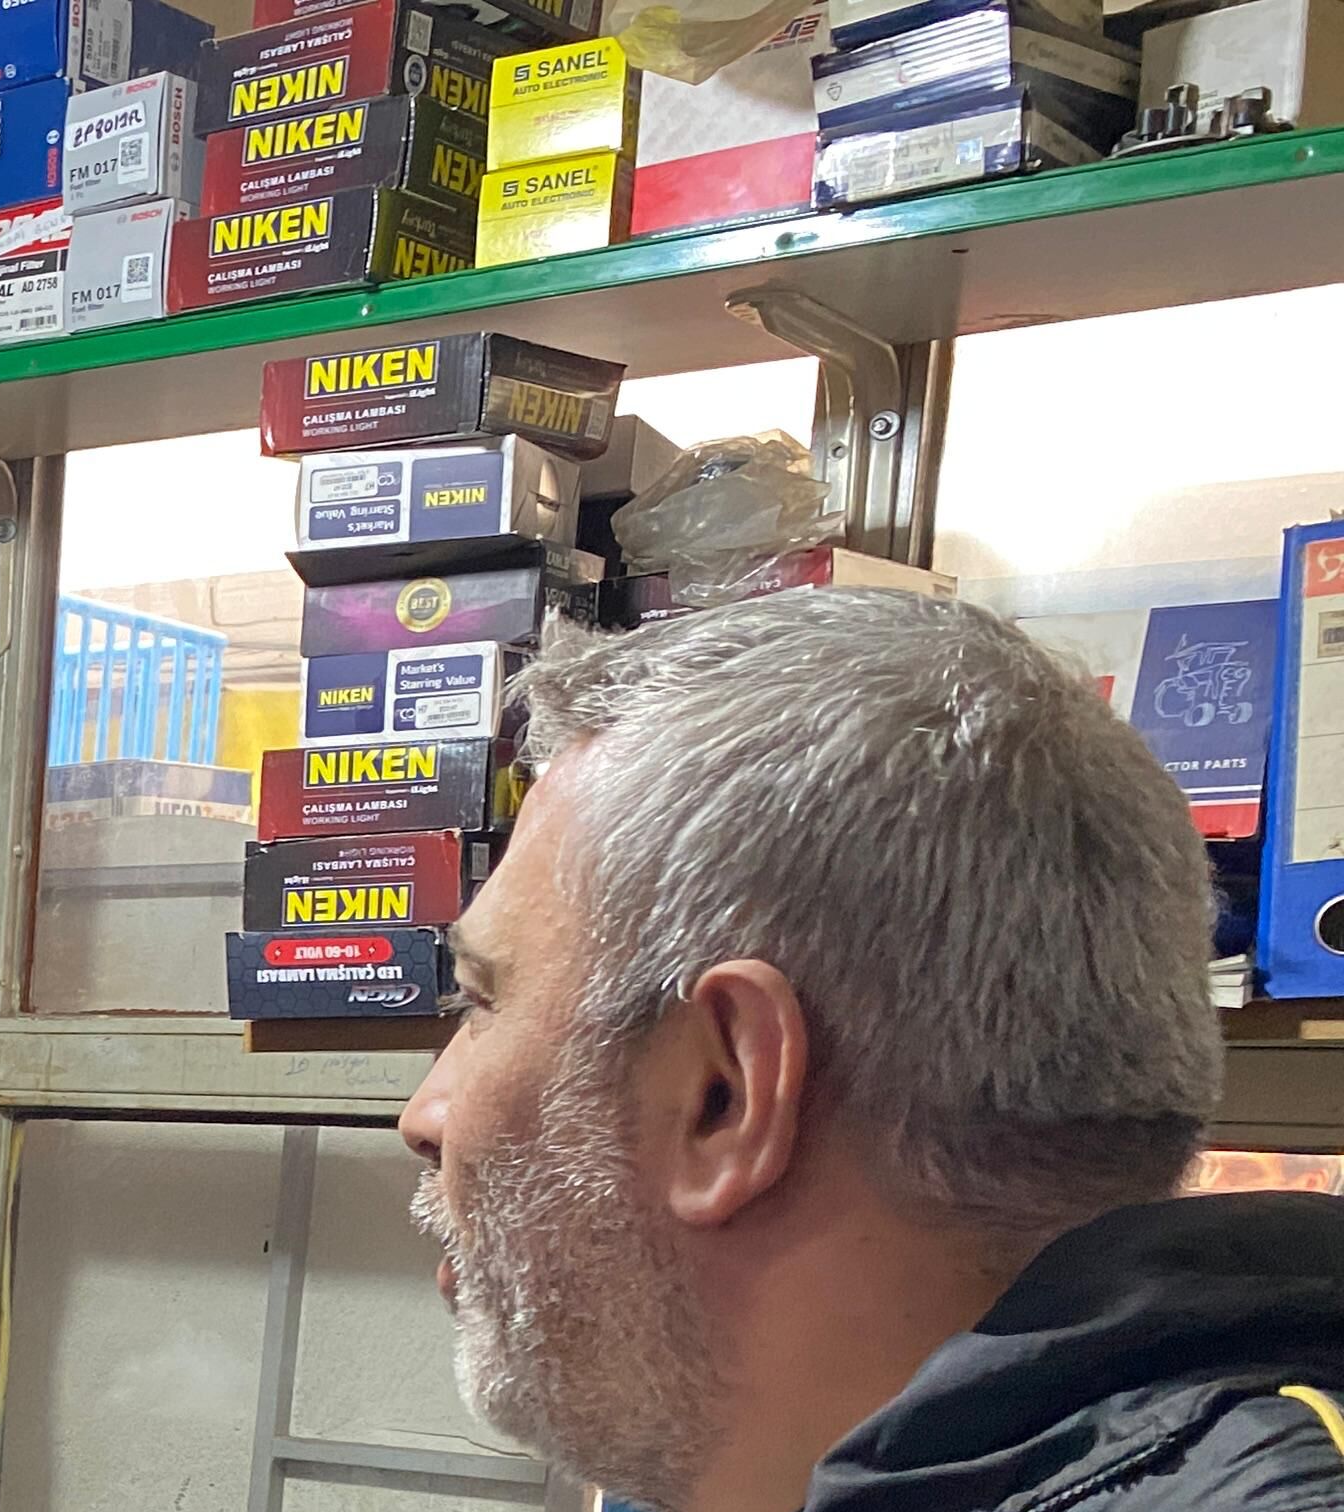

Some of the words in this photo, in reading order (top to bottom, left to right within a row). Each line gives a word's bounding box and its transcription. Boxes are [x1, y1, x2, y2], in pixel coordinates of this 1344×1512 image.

[536, 50, 609, 78] SANEL
[231, 60, 346, 117] NIKEN
[430, 64, 488, 114] IKEN
[512, 82, 541, 97] AUTO
[542, 69, 609, 91] ELECTRONIC
[171, 86, 184, 146] BOSCH
[246, 108, 364, 162] NIKEN
[69, 165, 90, 183] FM
[93, 158, 119, 177] 017
[430, 143, 487, 200] KEN
[524, 168, 597, 194] SANEL
[213, 201, 330, 254] NIKEN
[20, 279, 36, 293] AD
[35, 276, 59, 291] 2758
[71, 289, 93, 305] FM
[96, 283, 122, 301] 017
[308, 345, 438, 396] NIKEN
[302, 407, 352, 428] ÇALIŞMA
[353, 403, 407, 420] LAMBASI
[424, 487, 486, 508] NIKEN
[314, 508, 347, 520] Value
[400, 661, 446, 676] Market's
[444, 674, 476, 687] Value
[319, 686, 375, 707] NIKEN
[307, 745, 438, 787] NIKEN
[1204, 756, 1249, 772] PARTS
[302, 801, 354, 816] ÇALIŞMA
[355, 798, 408, 812] LAMBASI
[312, 858, 362, 872] LAMBASI
[363, 855, 416, 870] ÇALIŞMA
[285, 885, 410, 924] NIKEN
[377, 965, 403, 980] LED
